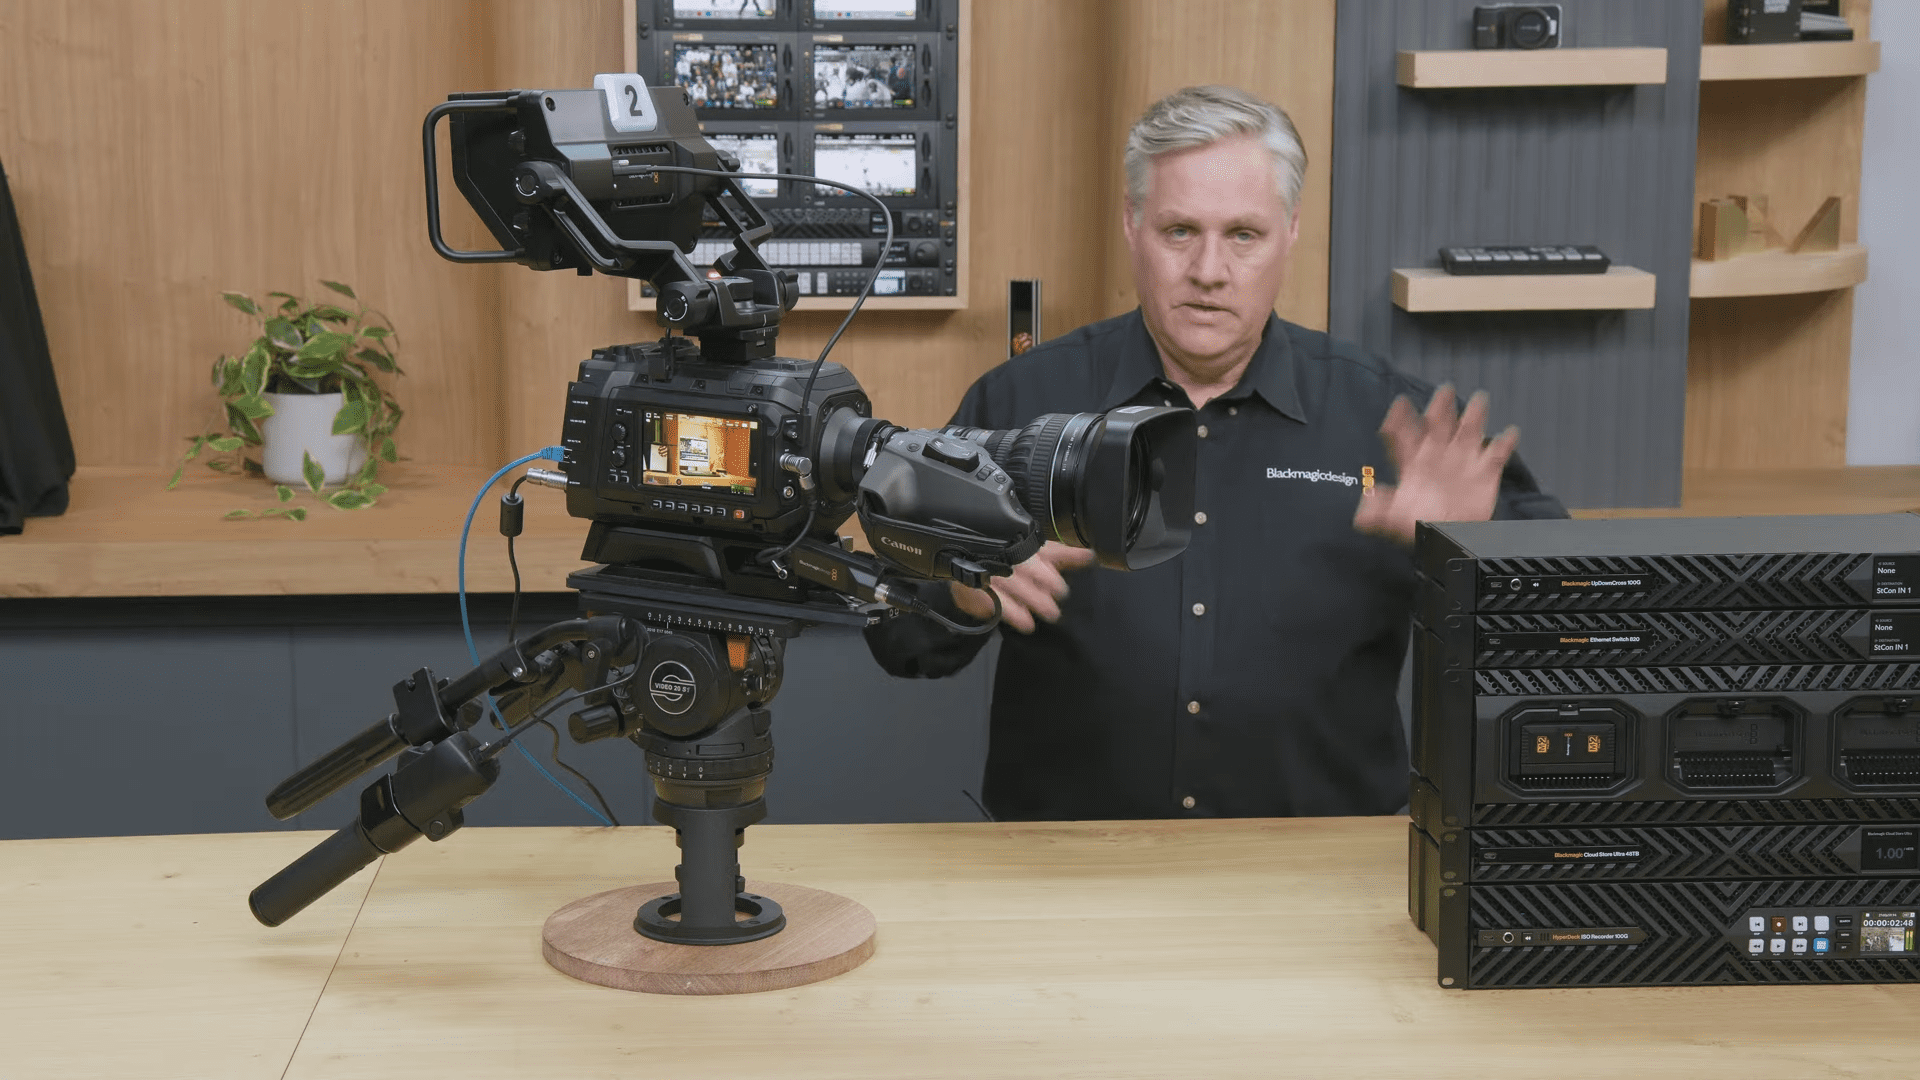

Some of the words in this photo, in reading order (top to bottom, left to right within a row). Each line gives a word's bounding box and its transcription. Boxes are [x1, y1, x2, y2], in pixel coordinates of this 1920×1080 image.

[624, 84, 643, 117] 2
[1266, 467, 1359, 487] Blackmagicdesign
[880, 535, 922, 556] Canon
[1873, 643, 1894, 651] StCon
[654, 682, 673, 691] VIDEO
[1875, 847, 1904, 859] 1.00
[1863, 919, 1914, 927] 00:00:02:48
